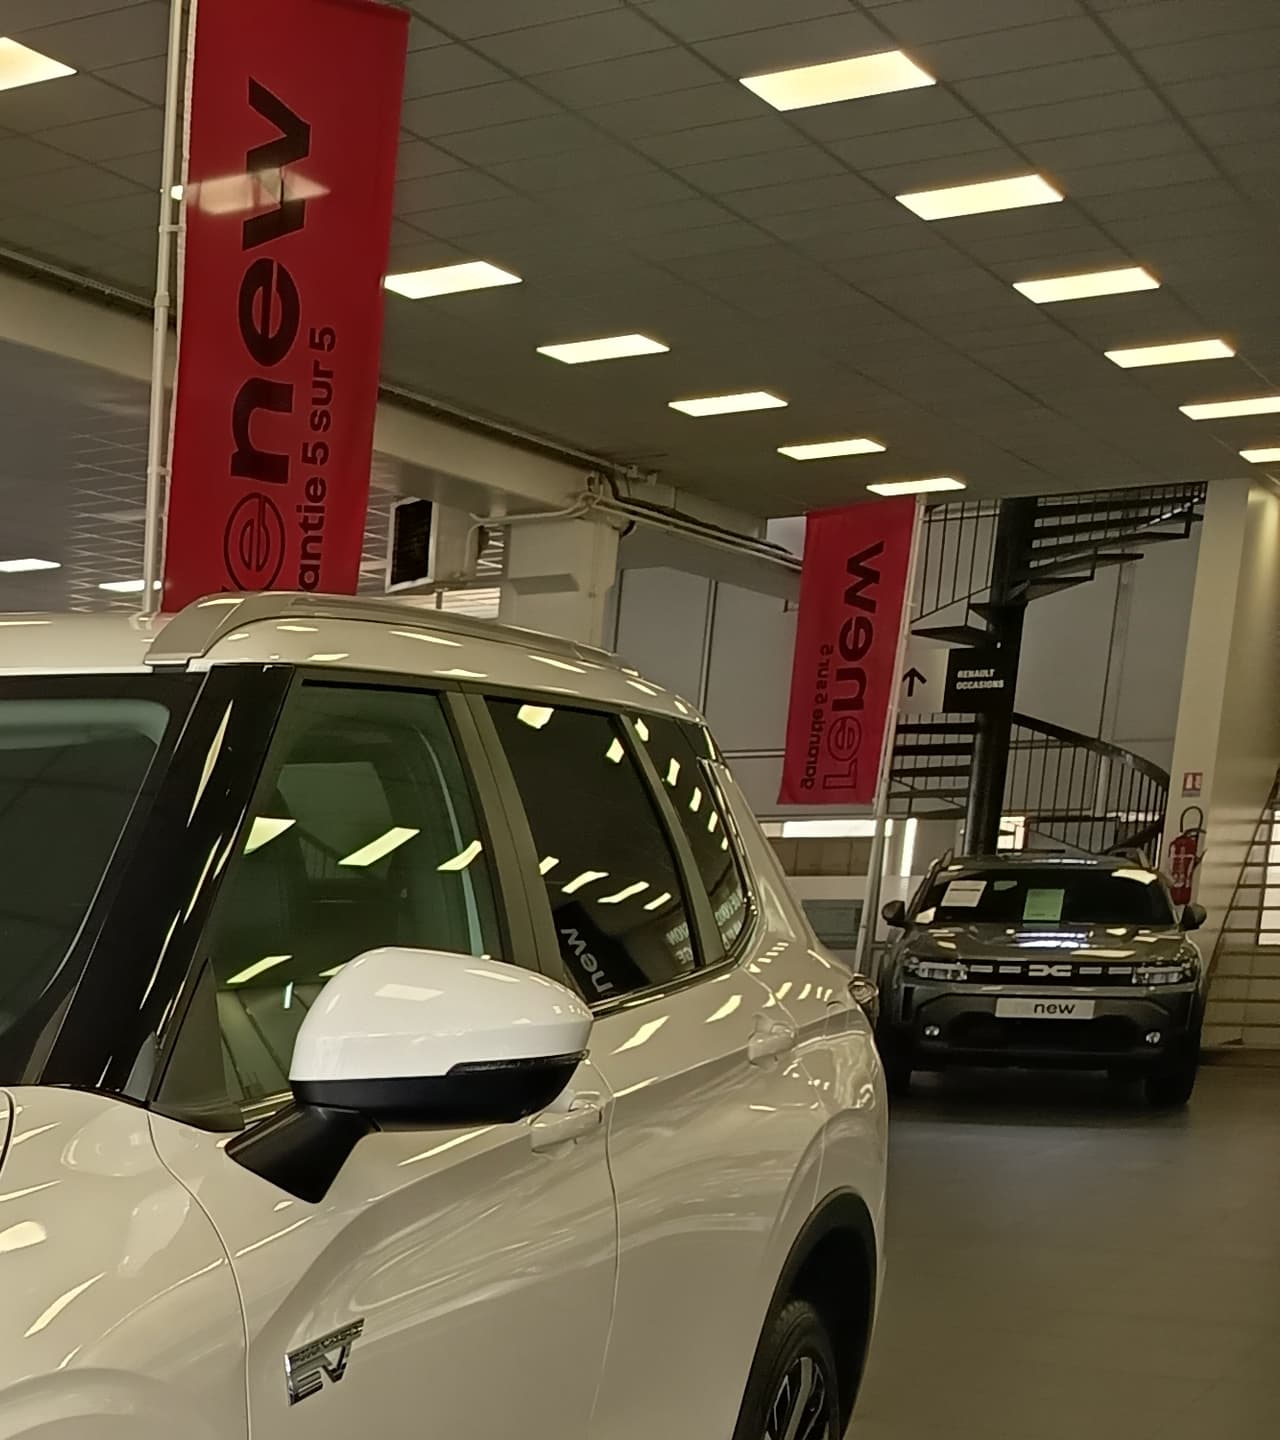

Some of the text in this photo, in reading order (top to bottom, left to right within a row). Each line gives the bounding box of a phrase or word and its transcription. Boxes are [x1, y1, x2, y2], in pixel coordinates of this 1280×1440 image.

[222, 76, 311, 592] enew
[296, 326, 337, 591] antie 5 sur 5
[956, 679, 1004, 690] OCCASIONS
[1033, 1003, 1076, 1014] new
